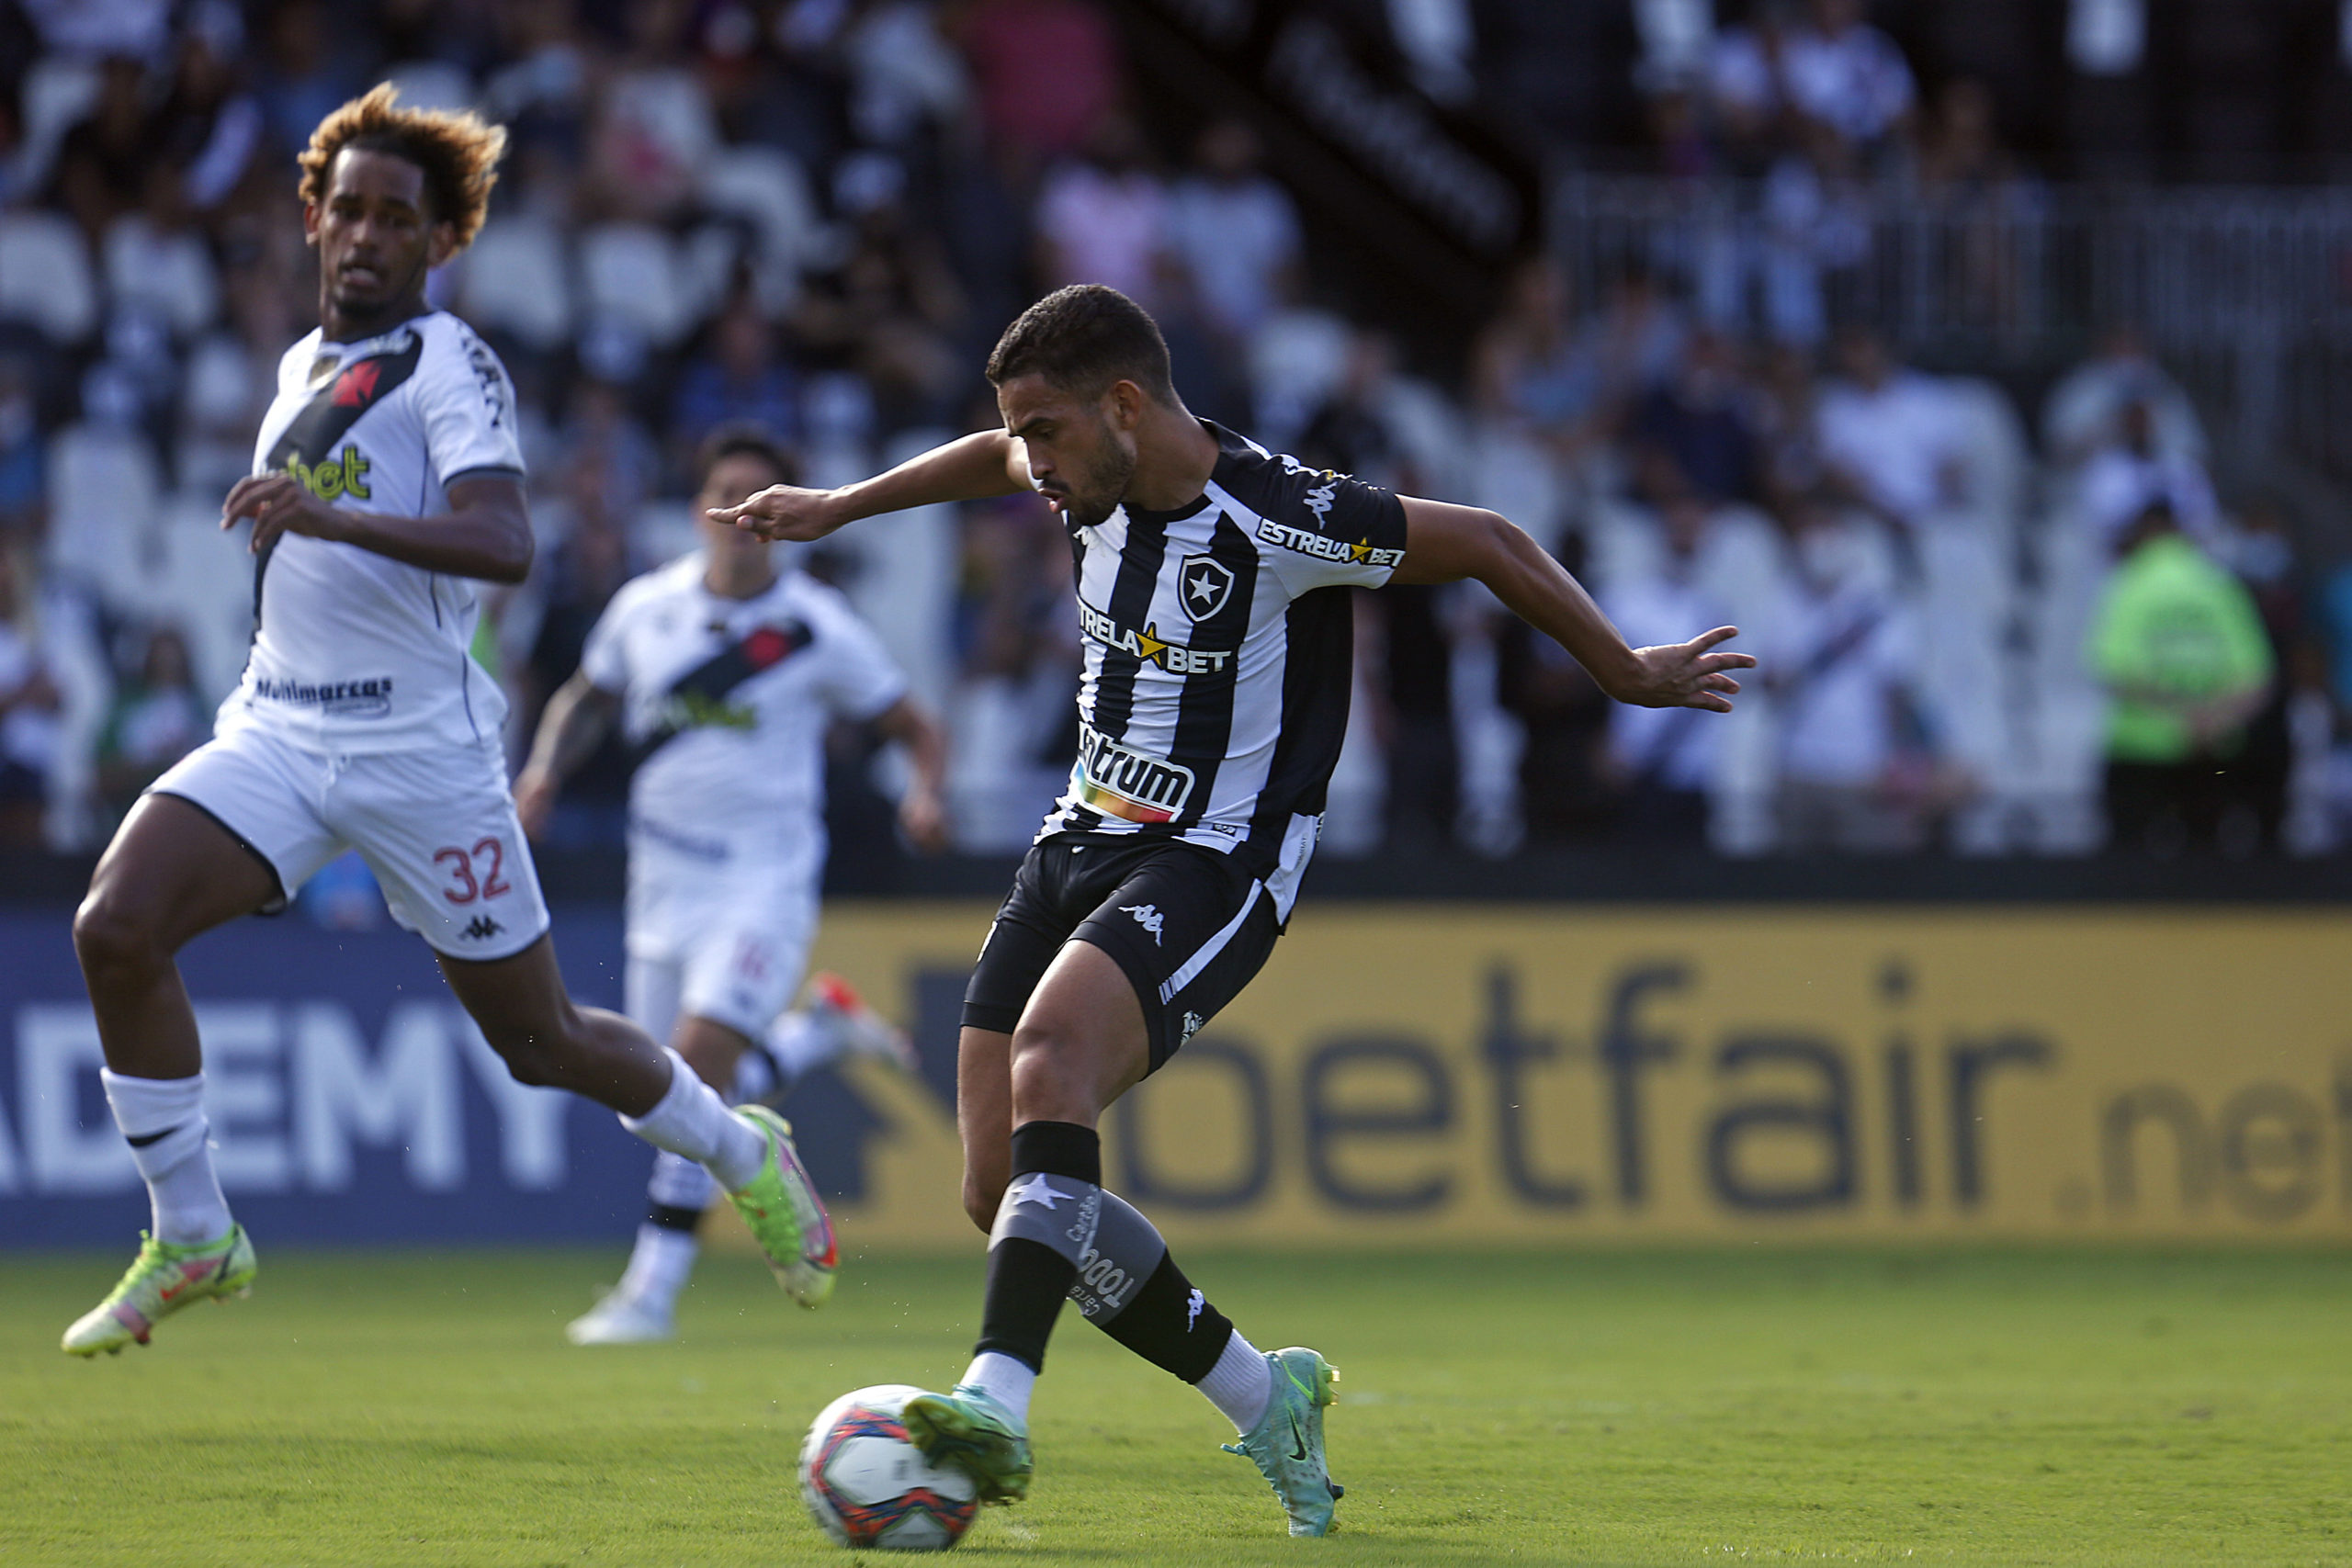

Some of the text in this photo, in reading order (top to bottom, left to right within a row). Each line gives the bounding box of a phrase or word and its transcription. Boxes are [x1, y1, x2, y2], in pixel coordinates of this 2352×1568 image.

[1258, 517, 1406, 568] ESTRELA BET
[1076, 594, 1232, 674] TRELA BET
[1079, 726, 1189, 807] ntrum
[433, 835, 511, 907] 32
[0, 999, 574, 1190] DEMY
